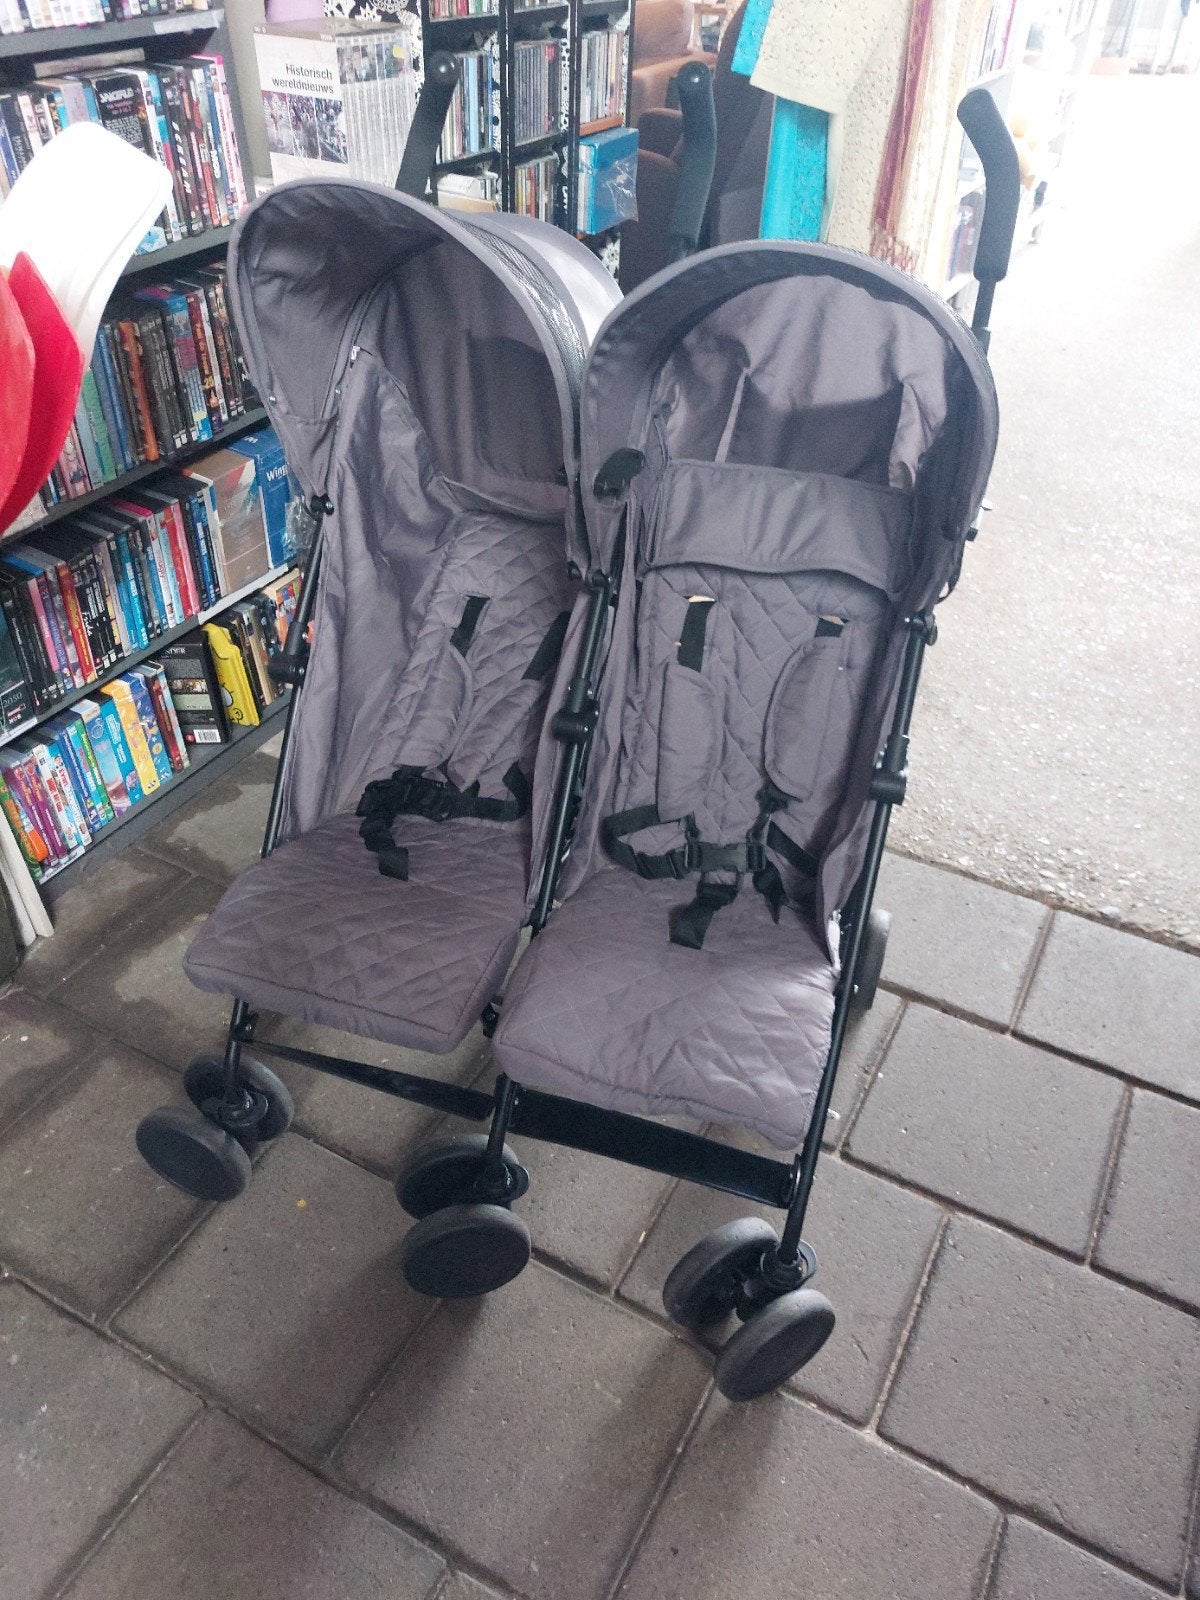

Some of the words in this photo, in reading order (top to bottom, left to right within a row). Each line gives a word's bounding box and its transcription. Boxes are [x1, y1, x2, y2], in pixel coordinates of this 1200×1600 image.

[285, 63, 333, 80] Historisch
[272, 77, 334, 94] wereldnieuws
[171, 121, 192, 194] SCREAM
